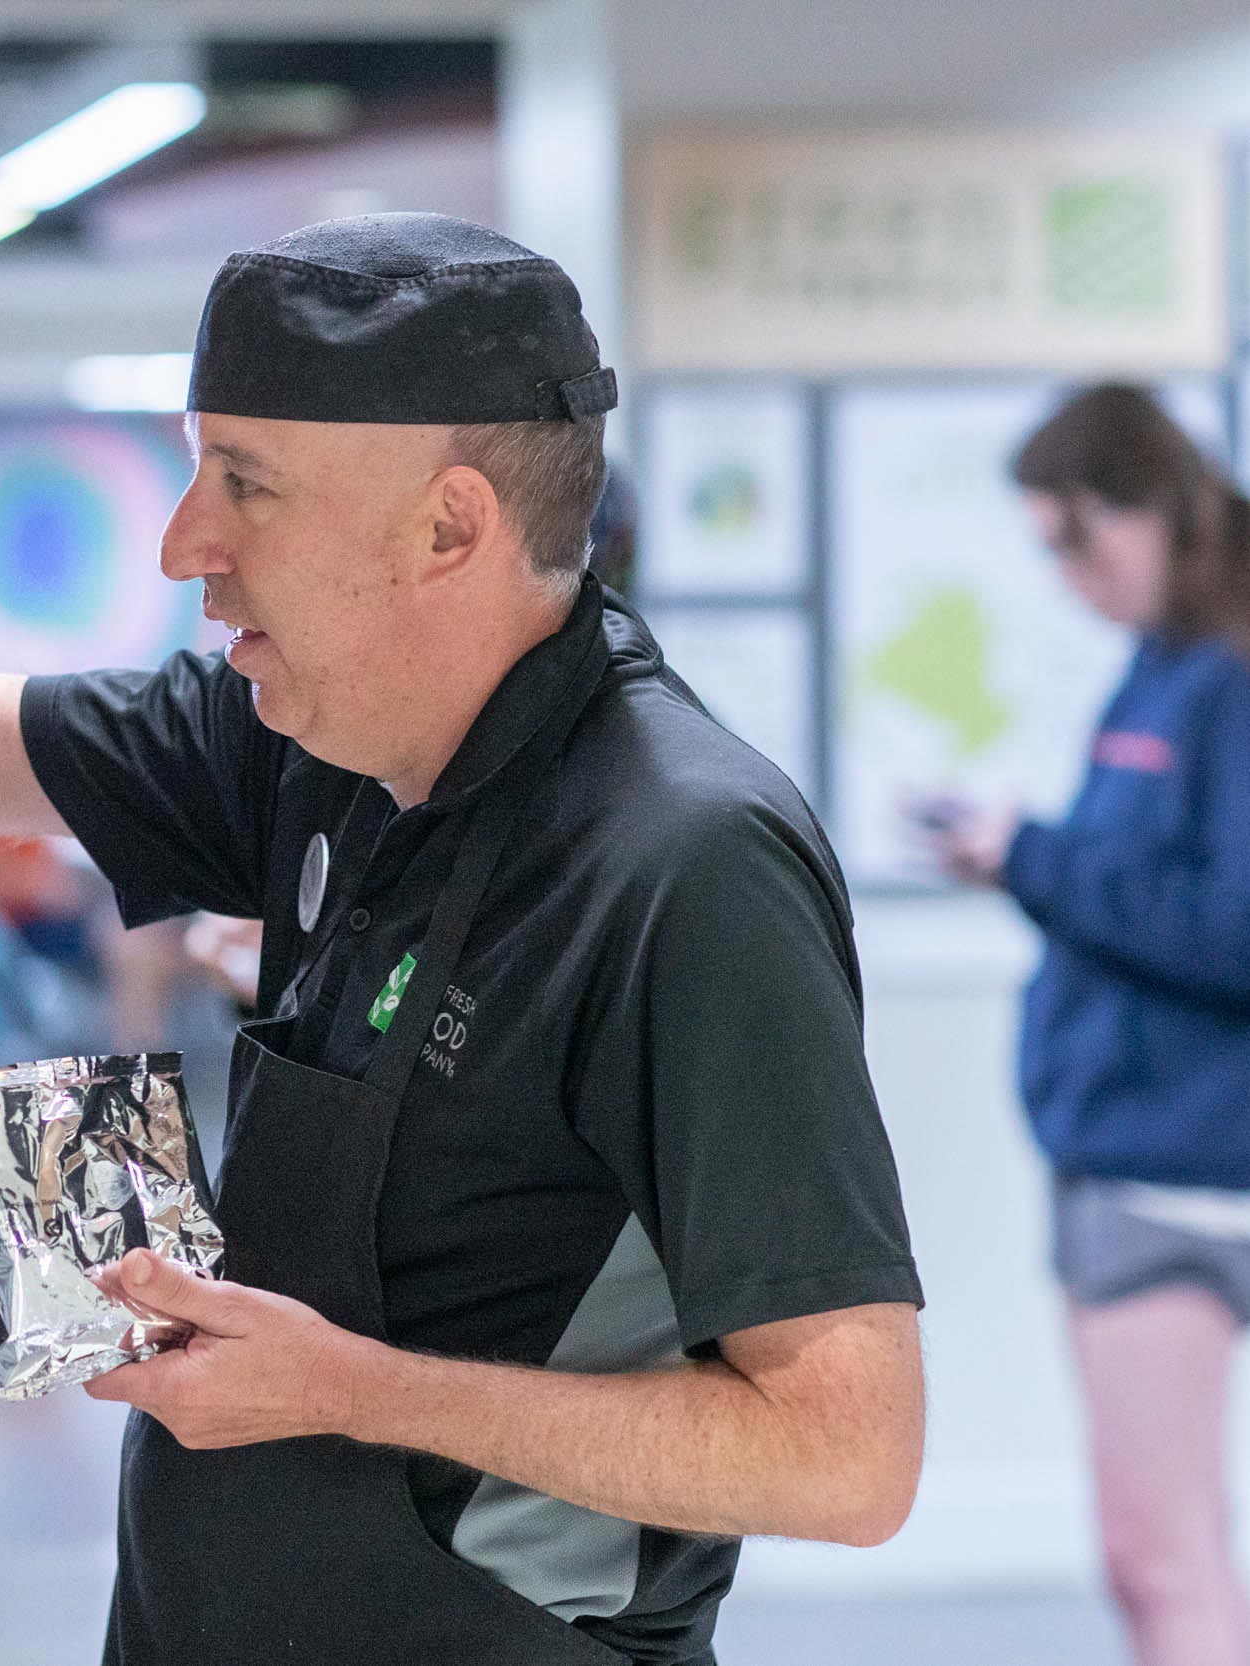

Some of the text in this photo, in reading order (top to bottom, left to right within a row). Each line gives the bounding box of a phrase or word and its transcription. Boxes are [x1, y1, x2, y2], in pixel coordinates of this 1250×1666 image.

[443, 984, 477, 1016] FRESH
[433, 1012, 467, 1050] OD
[420, 1043, 455, 1075] PANY
